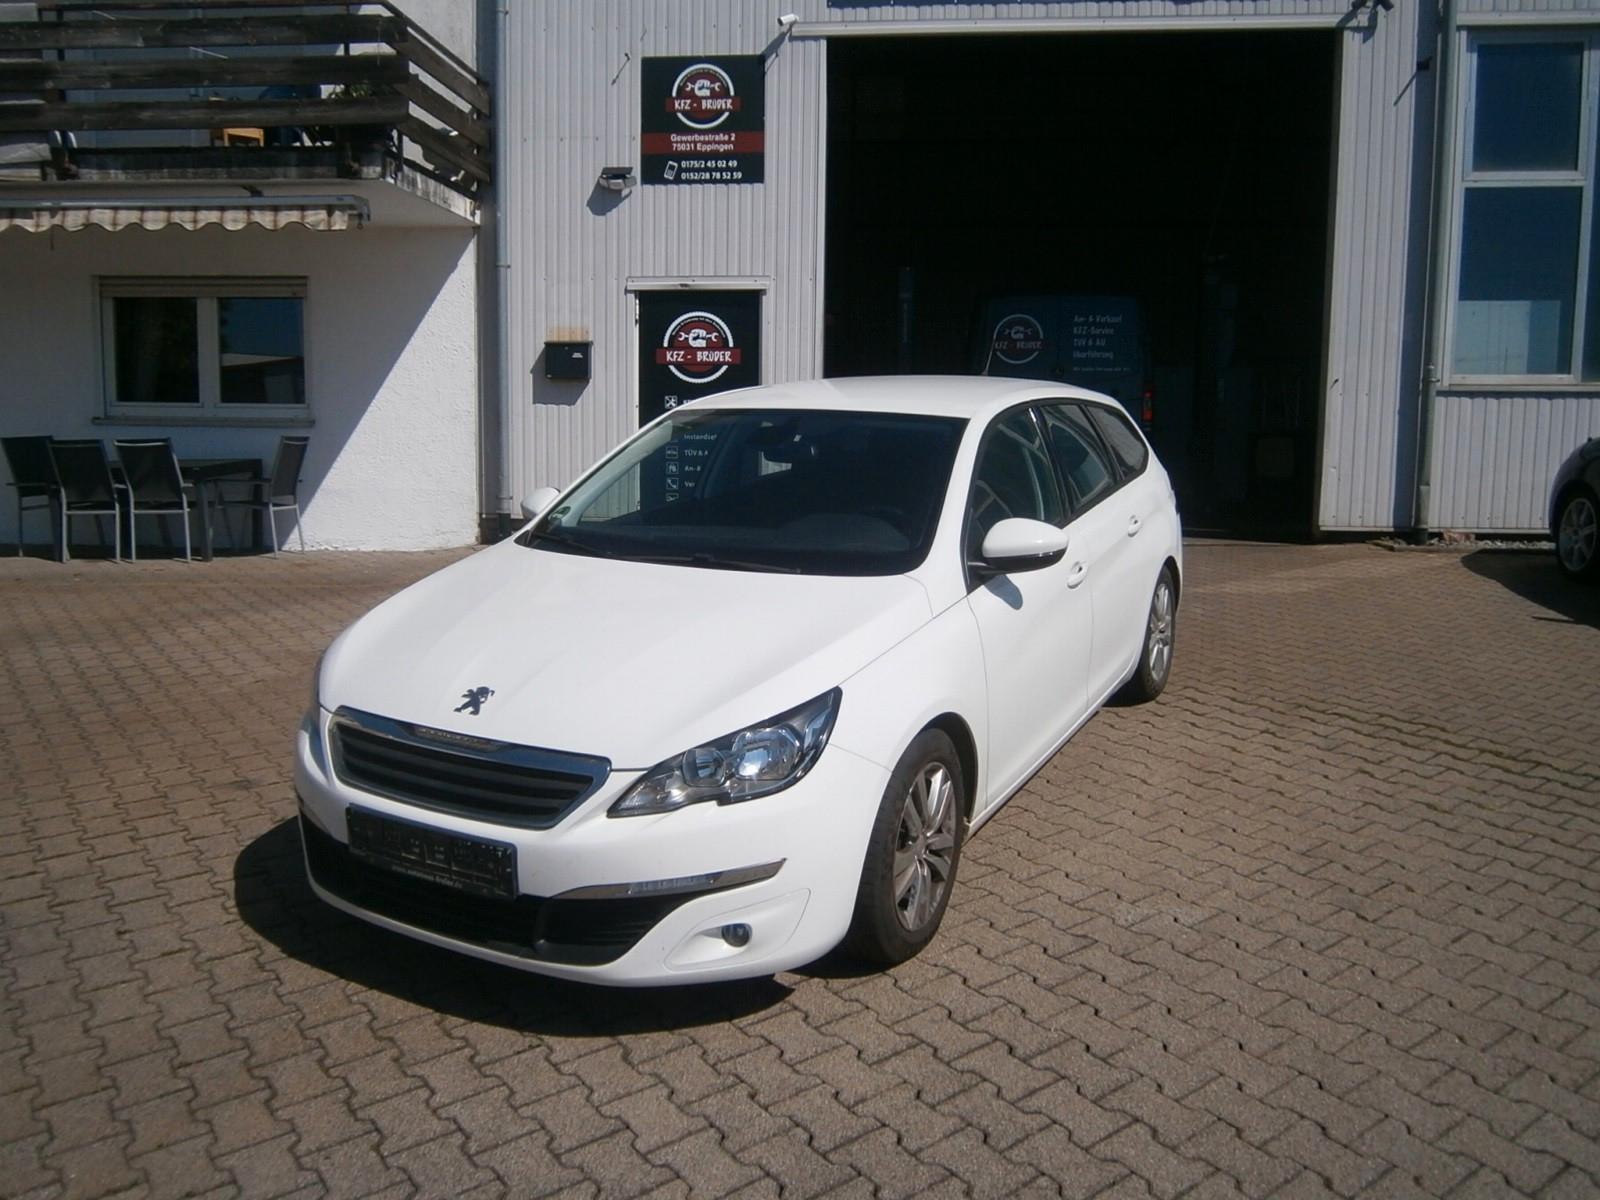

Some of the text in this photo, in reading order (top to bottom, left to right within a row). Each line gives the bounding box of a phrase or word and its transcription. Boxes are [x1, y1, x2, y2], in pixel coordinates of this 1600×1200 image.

[674, 99, 691, 110] KFZ
[671, 133, 736, 142] Gewerbestraße 2
[672, 143, 734, 152] 75031 Eppingen
[681, 160, 738, 168] 0175/2 45 02 49
[666, 351, 685, 362] KFZ
